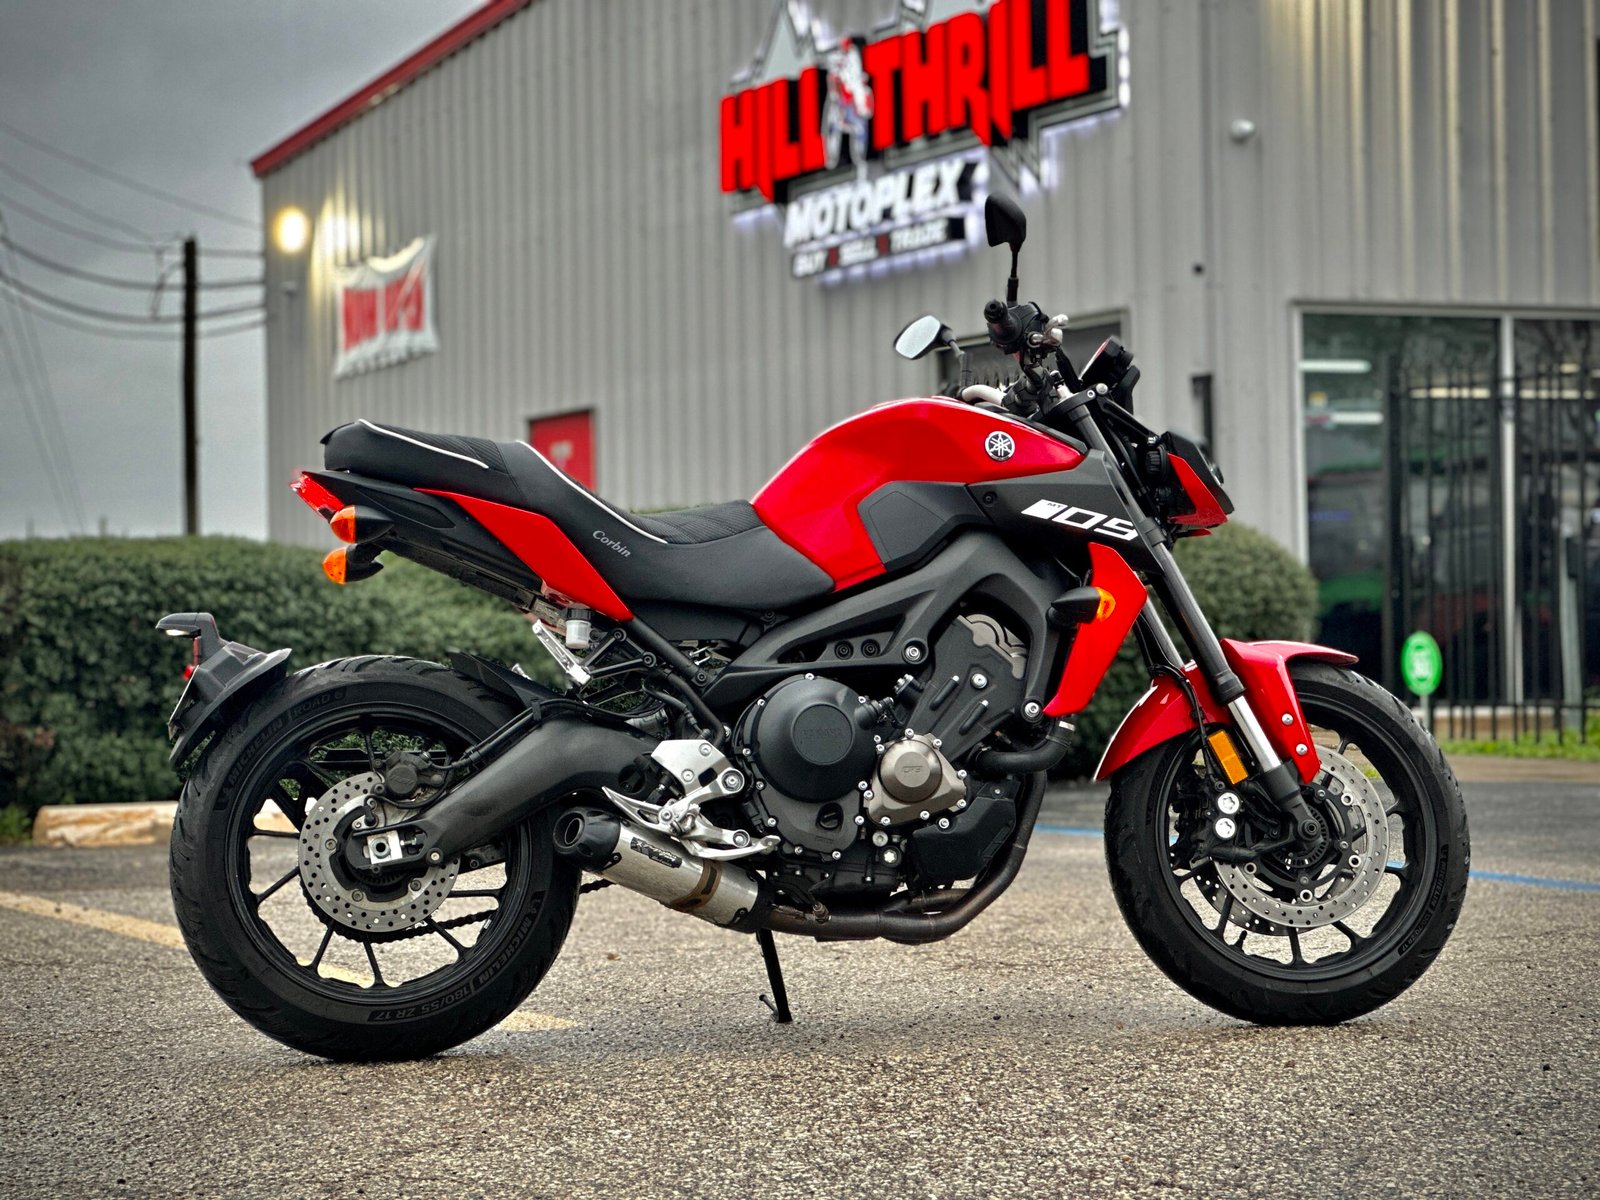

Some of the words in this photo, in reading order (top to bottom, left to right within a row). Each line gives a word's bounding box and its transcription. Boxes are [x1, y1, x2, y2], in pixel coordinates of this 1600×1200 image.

[720, 66, 825, 202] HILL
[863, 0, 1090, 147] THRILL
[784, 158, 965, 248] MOTOPLEX
[592, 529, 631, 558] Corbin
[228, 718, 284, 786] MICHELIN
[294, 693, 331, 717] ROAD
[478, 916, 534, 985] MICHELIN
[375, 1011, 391, 1021] 17
[395, 1005, 417, 1019] ZR
[421, 987, 471, 1013] 180/55
